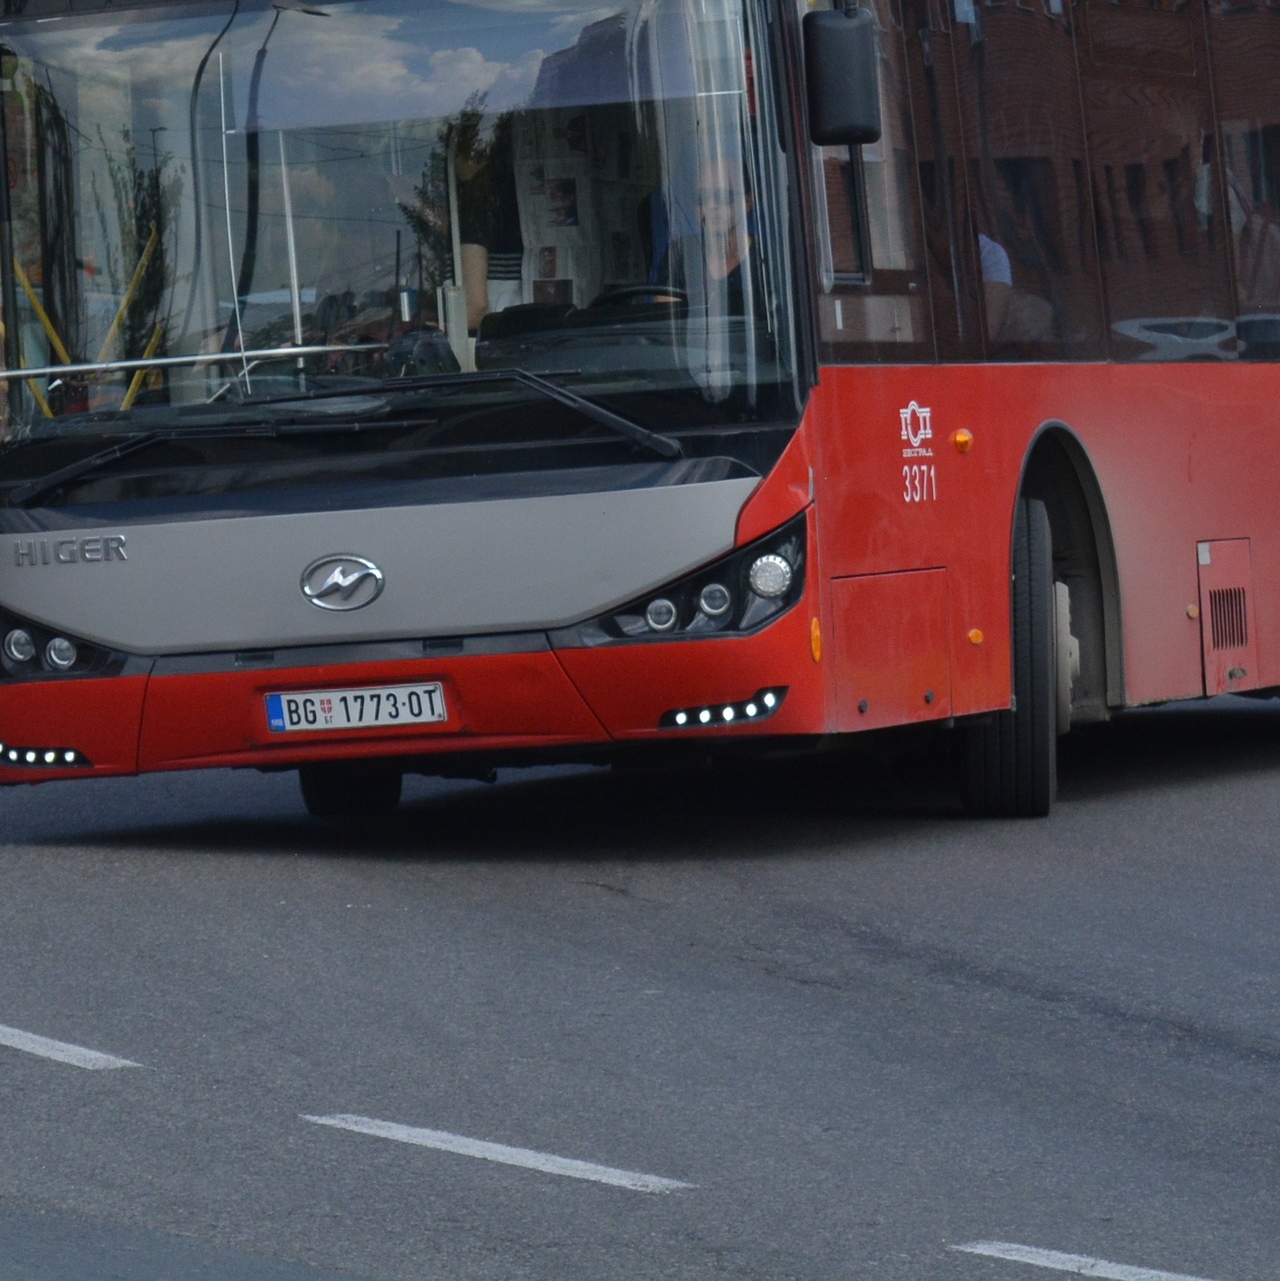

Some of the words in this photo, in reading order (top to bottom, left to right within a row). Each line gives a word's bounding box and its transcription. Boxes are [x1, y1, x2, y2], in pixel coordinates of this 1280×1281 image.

[902, 465, 937, 502] 3371
[14, 535, 128, 567] HIGER
[286, 698, 317, 726] BG
